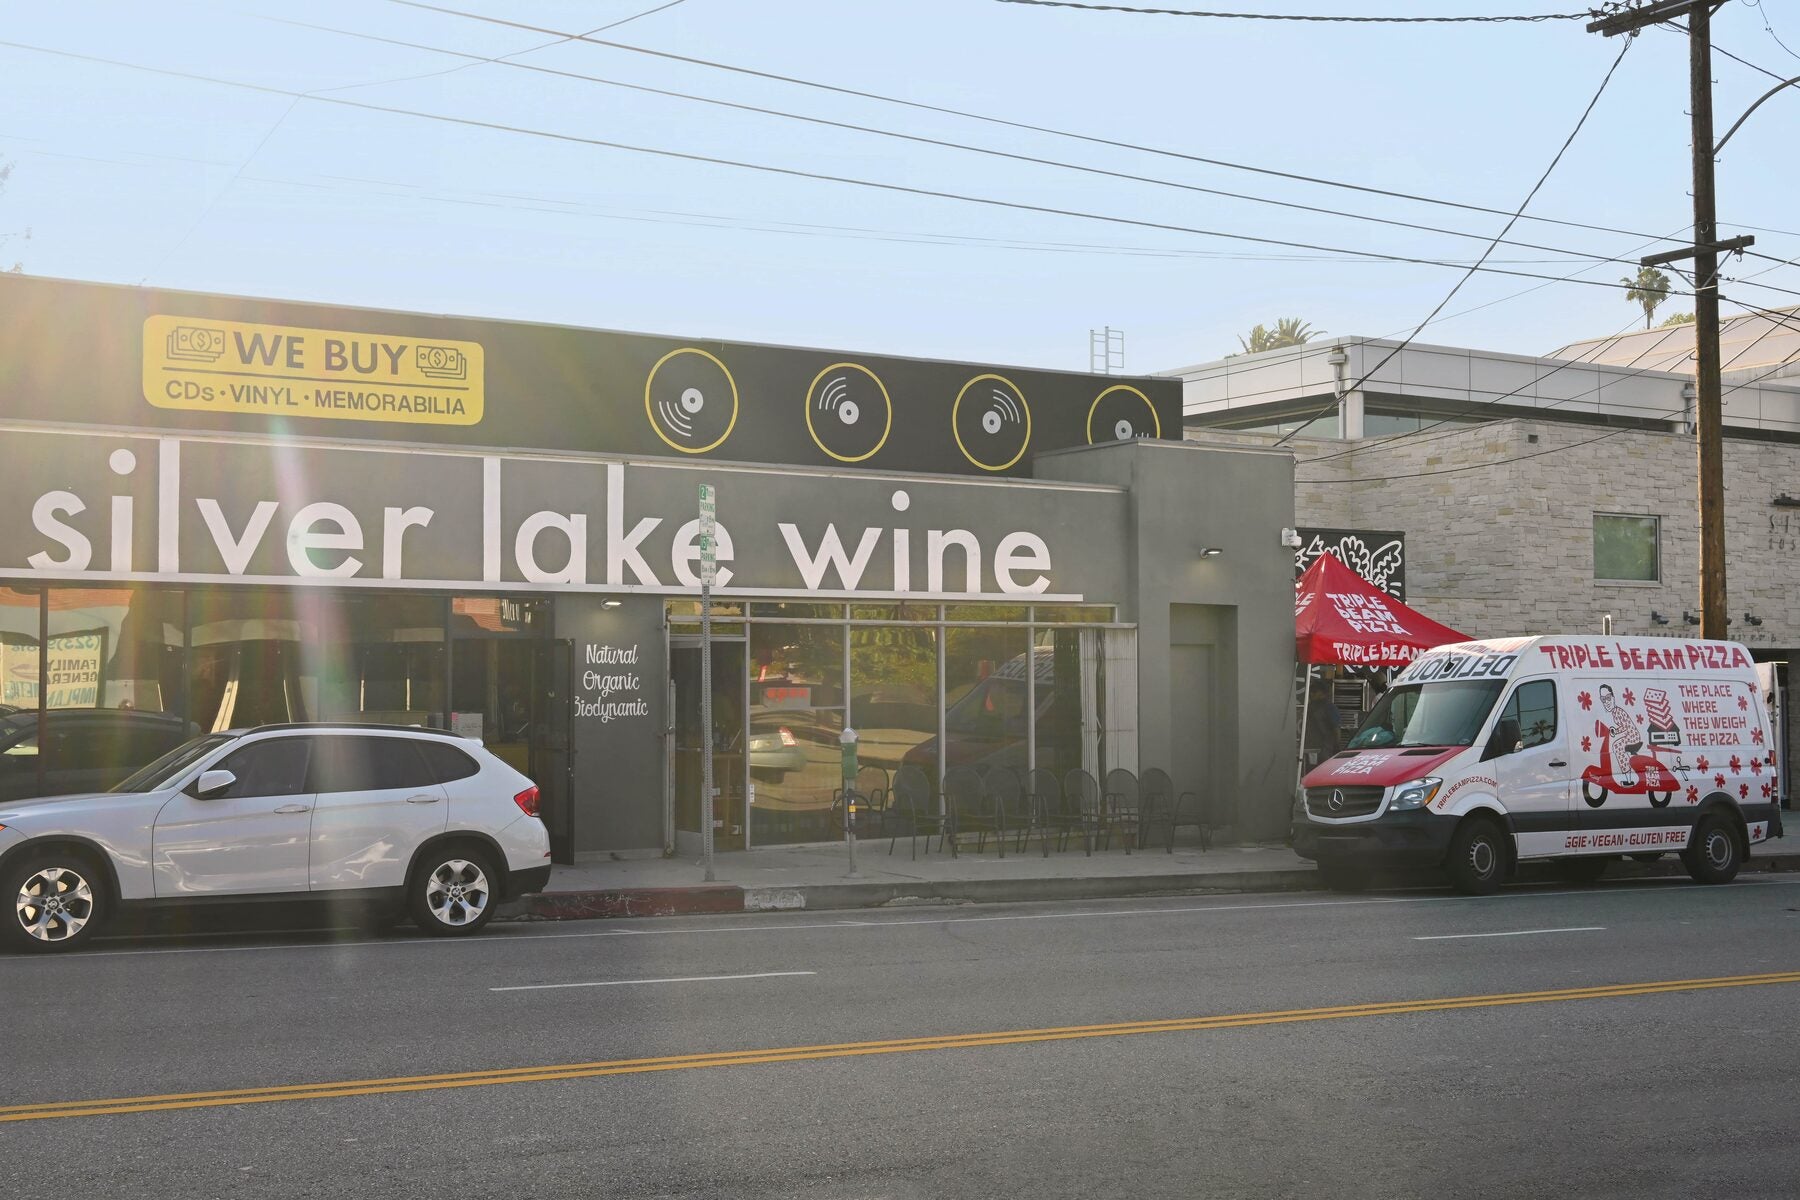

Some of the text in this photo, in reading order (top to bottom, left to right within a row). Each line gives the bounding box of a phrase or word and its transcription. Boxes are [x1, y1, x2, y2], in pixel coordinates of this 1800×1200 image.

[234, 332, 408, 375] WE BUY
[165, 380, 466, 415] CDs VINYL MEMORABILIA
[27, 439, 1051, 594] silver lake wine
[1325, 593, 1388, 610] TRIPLE
[586, 644, 639, 664] Natural
[1333, 642, 1380, 662] TRIPLE
[1540, 644, 1614, 669] TRIPLE
[583, 670, 640, 697] Organic
[1678, 685, 1732, 697] THE PLACE
[1681, 701, 1718, 713] WHERE
[1683, 716, 1746, 729] THEY WEIGH
[1686, 733, 1740, 746] THE PIZZA
[1437, 776, 1498, 810] TRIPLEBEAMPIZZA.COM
[1592, 834, 1624, 847] VEGAN
[1629, 832, 1662, 845] GLUTEN
[1665, 831, 1686, 843] FREE
